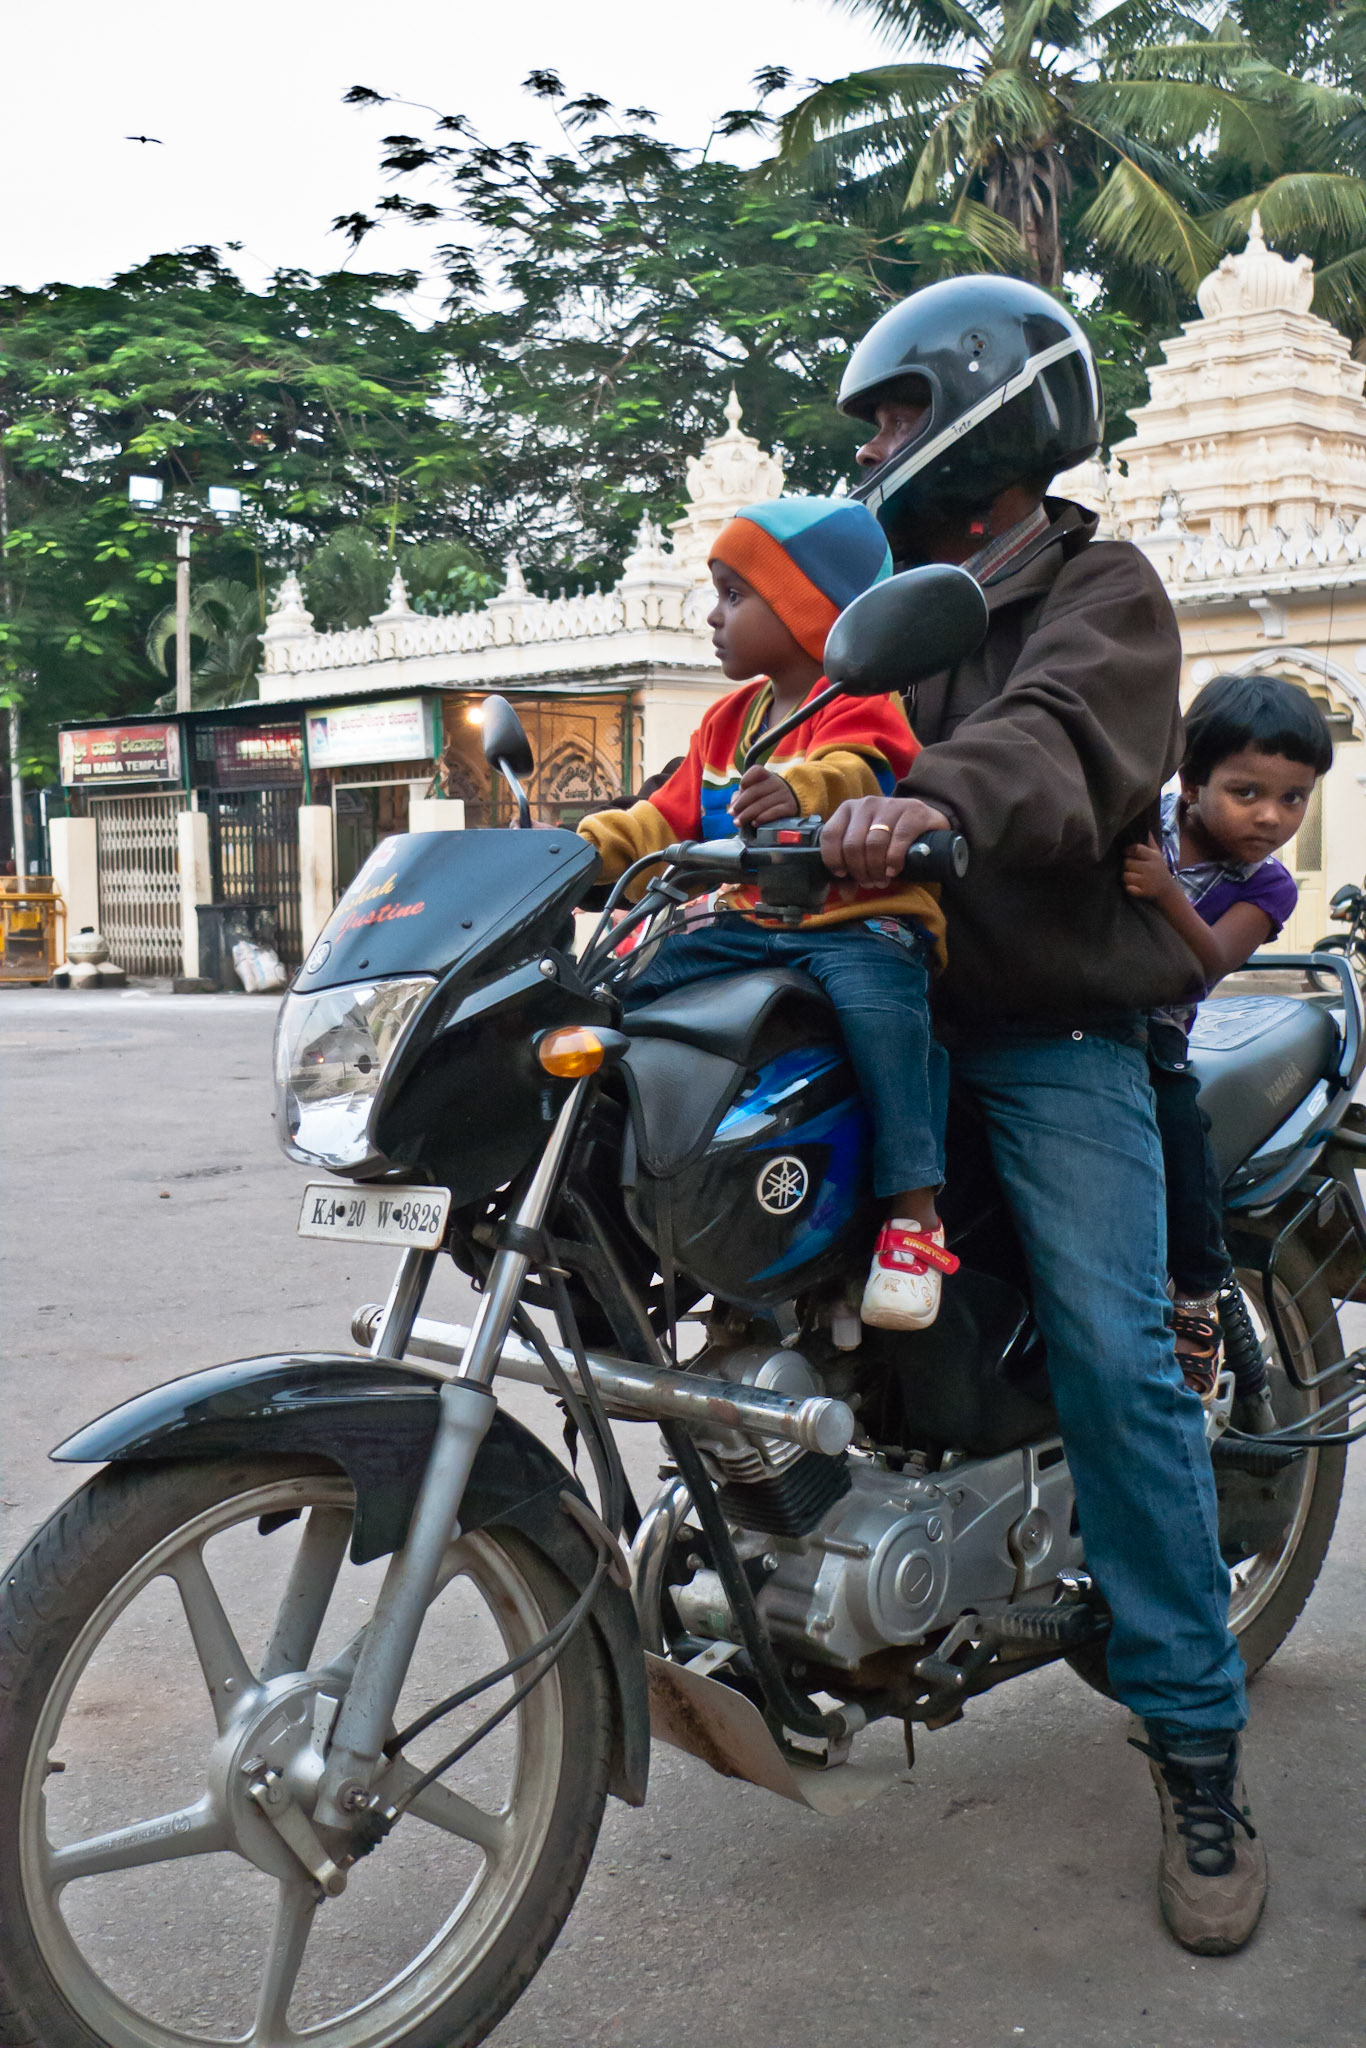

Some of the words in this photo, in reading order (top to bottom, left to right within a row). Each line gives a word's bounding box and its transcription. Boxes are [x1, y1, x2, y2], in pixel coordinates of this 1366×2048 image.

[74, 763, 92, 775] SRI
[93, 761, 123, 774] RAMA
[125, 759, 168, 772] TEMPLE
[335, 901, 425, 944] Justine
[1264, 1062, 1304, 1106] YAMAHA
[311, 1198, 337, 1226] KA
[347, 1200, 366, 1227] 20
[377, 1201, 394, 1229] W
[399, 1201, 442, 1234] 3828
